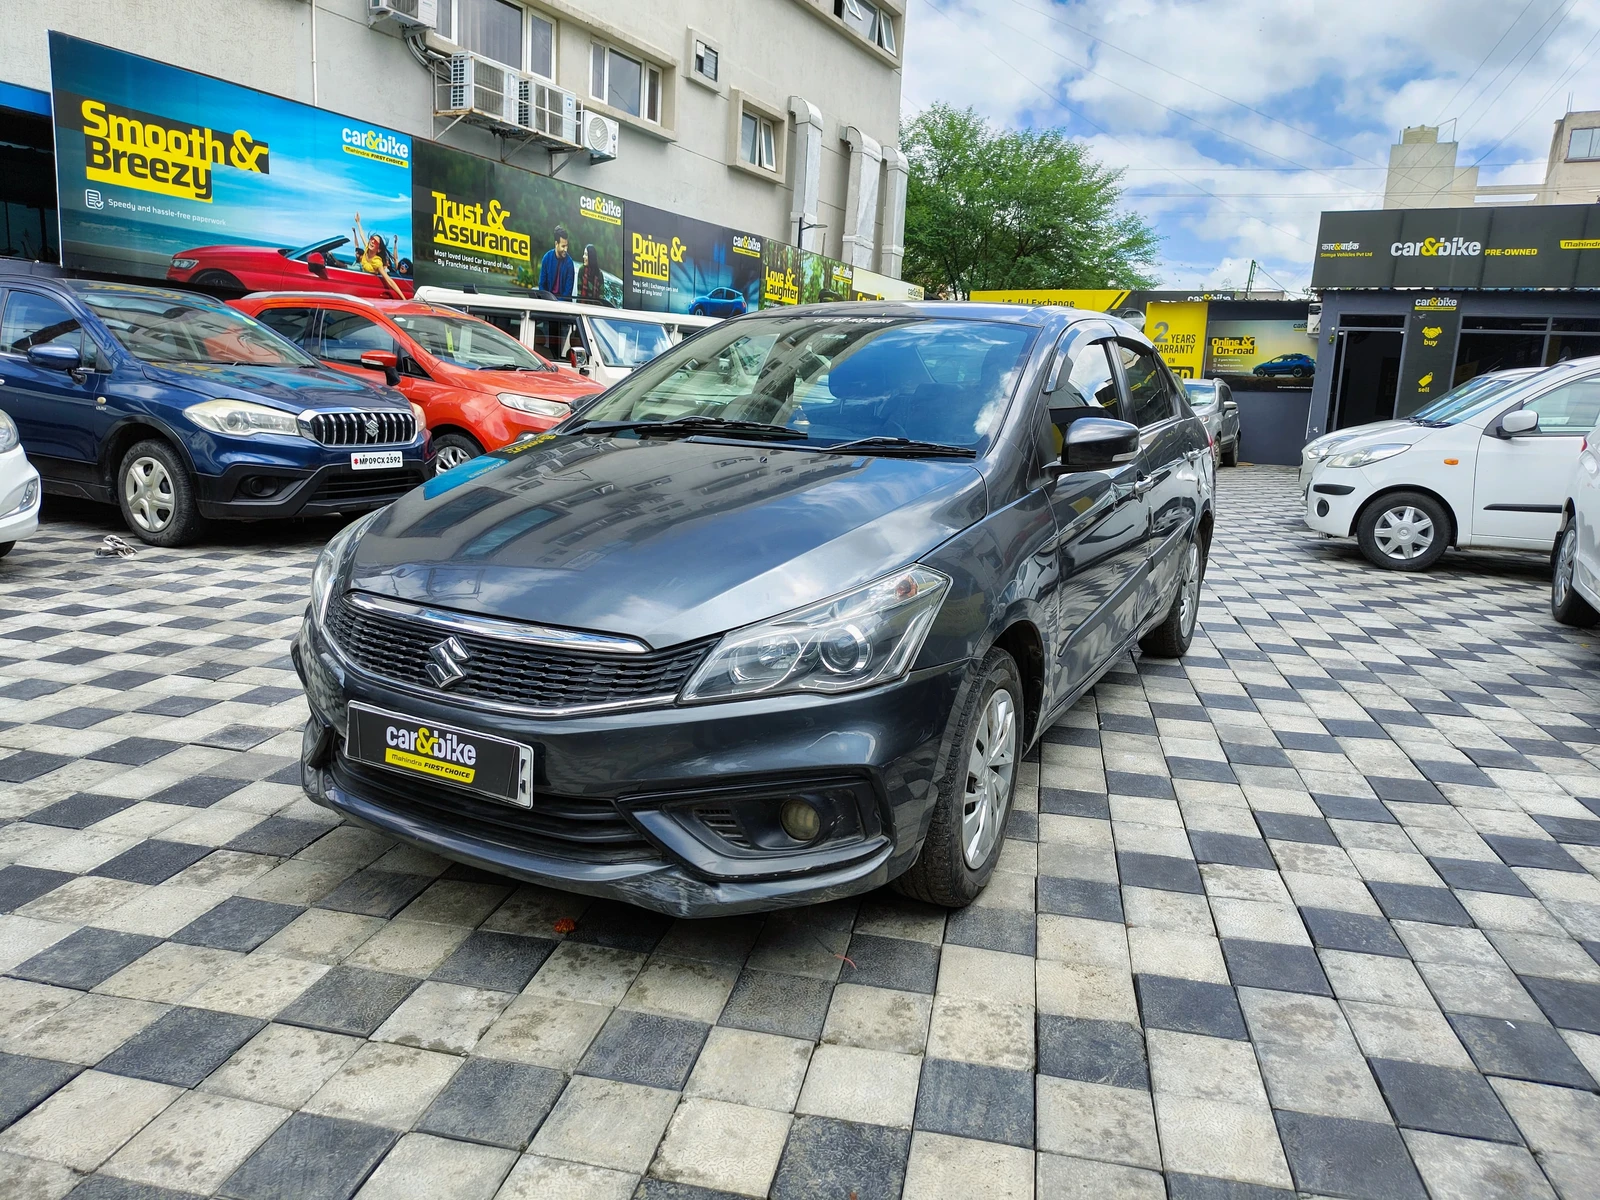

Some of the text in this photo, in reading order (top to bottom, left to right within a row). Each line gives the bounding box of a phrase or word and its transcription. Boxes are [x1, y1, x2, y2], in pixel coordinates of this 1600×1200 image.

[81, 99, 269, 173] Smooth &
[342, 127, 409, 158] car&bike
[87, 138, 213, 199] Breezy
[108, 198, 226, 226] Speedy and hassle-free paperwork
[431, 191, 511, 231] Trust &
[580, 195, 621, 217] car&bike
[434, 215, 529, 257] Assurance
[733, 235, 760, 251] car&bike
[1390, 237, 1481, 257] car&bike
[632, 232, 687, 263] Drive &
[1484, 248, 1538, 257] PRE-OWNED
[434, 249, 514, 270] Most loved Used Car brand of India
[437, 258, 445, 267] By
[445, 260, 469, 270] Franchise
[632, 253, 668, 277] Smile
[765, 266, 796, 287] Love &
[765, 282, 798, 299] Laughter
[1415, 297, 1457, 306] car&bike
[1153, 321, 1196, 344] 2 YEARS
[1211, 334, 1255, 348] Online &
[1423, 339, 1438, 347] buy
[1216, 346, 1255, 355] On-road
[386, 725, 477, 766] car&bike
[391, 753, 471, 779] Mahindra FIRST CHOICE
